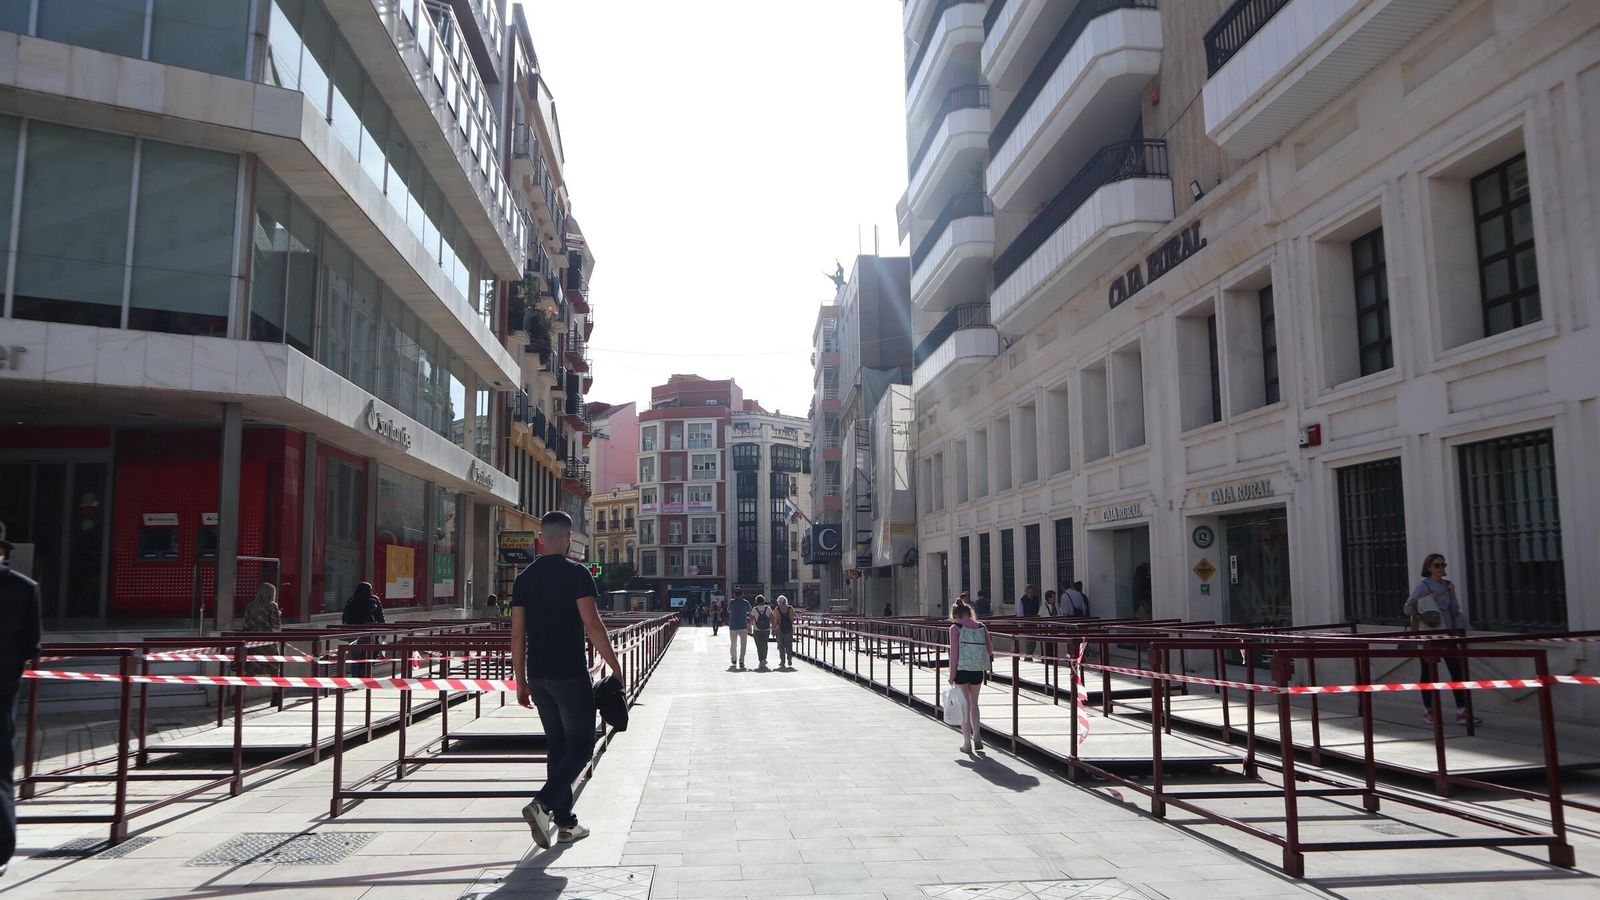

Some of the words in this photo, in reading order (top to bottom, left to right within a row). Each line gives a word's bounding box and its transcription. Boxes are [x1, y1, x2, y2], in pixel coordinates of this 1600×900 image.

[1108, 264, 1145, 310] CAJA
[1146, 220, 1208, 285] RURAL
[376, 411, 413, 449] Santander
[1211, 486, 1236, 505] CAJA
[1236, 480, 1275, 501] RURAL
[1103, 506, 1118, 522] CAJA
[1118, 502, 1143, 520] RURAL
[818, 528, 838, 551] C
